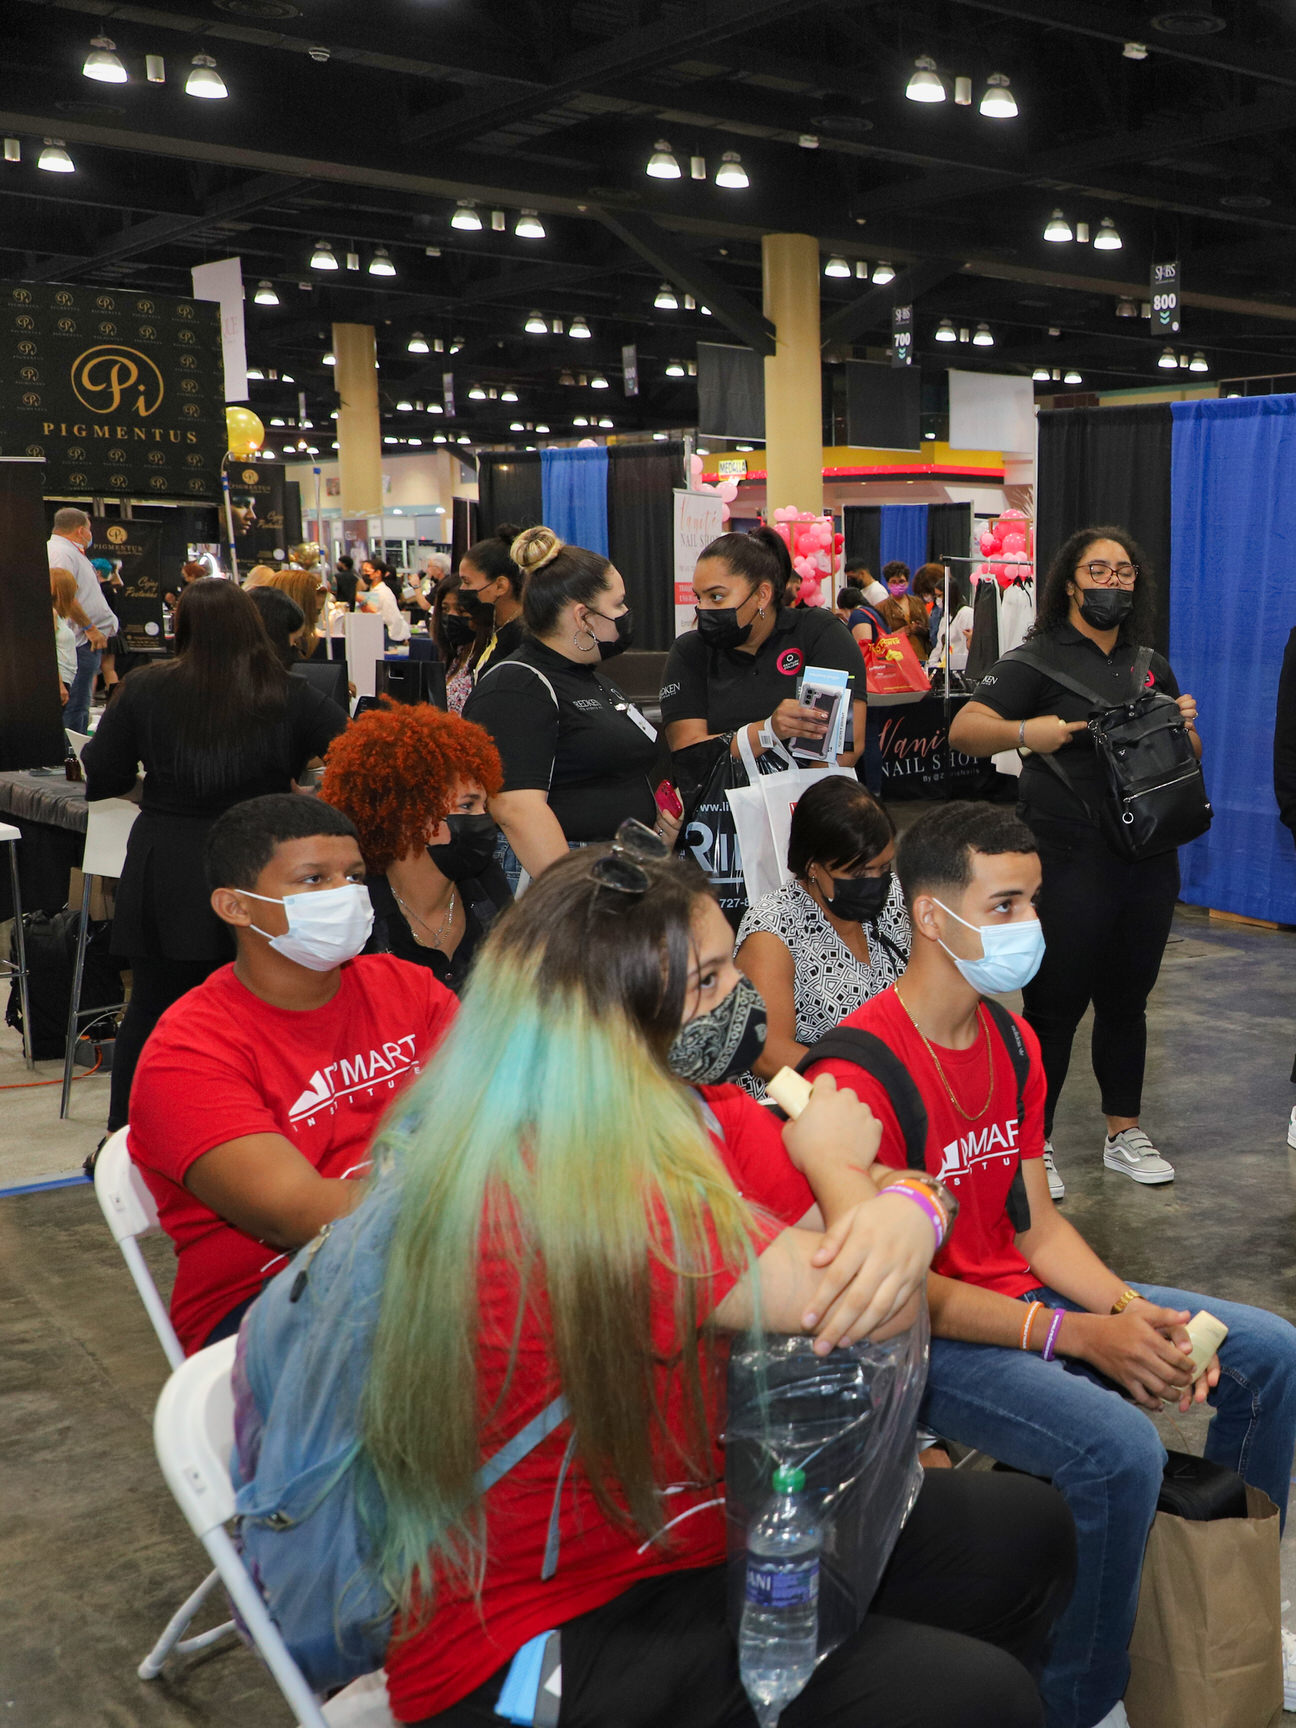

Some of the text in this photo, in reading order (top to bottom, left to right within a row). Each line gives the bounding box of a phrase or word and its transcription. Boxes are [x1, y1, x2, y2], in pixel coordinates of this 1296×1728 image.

[1153, 293, 1176, 310] 800
[894, 332, 911, 347] 700
[43, 422, 198, 444] PIGMENTUS
[878, 716, 945, 759] Vani
[881, 757, 925, 777] NAIL
